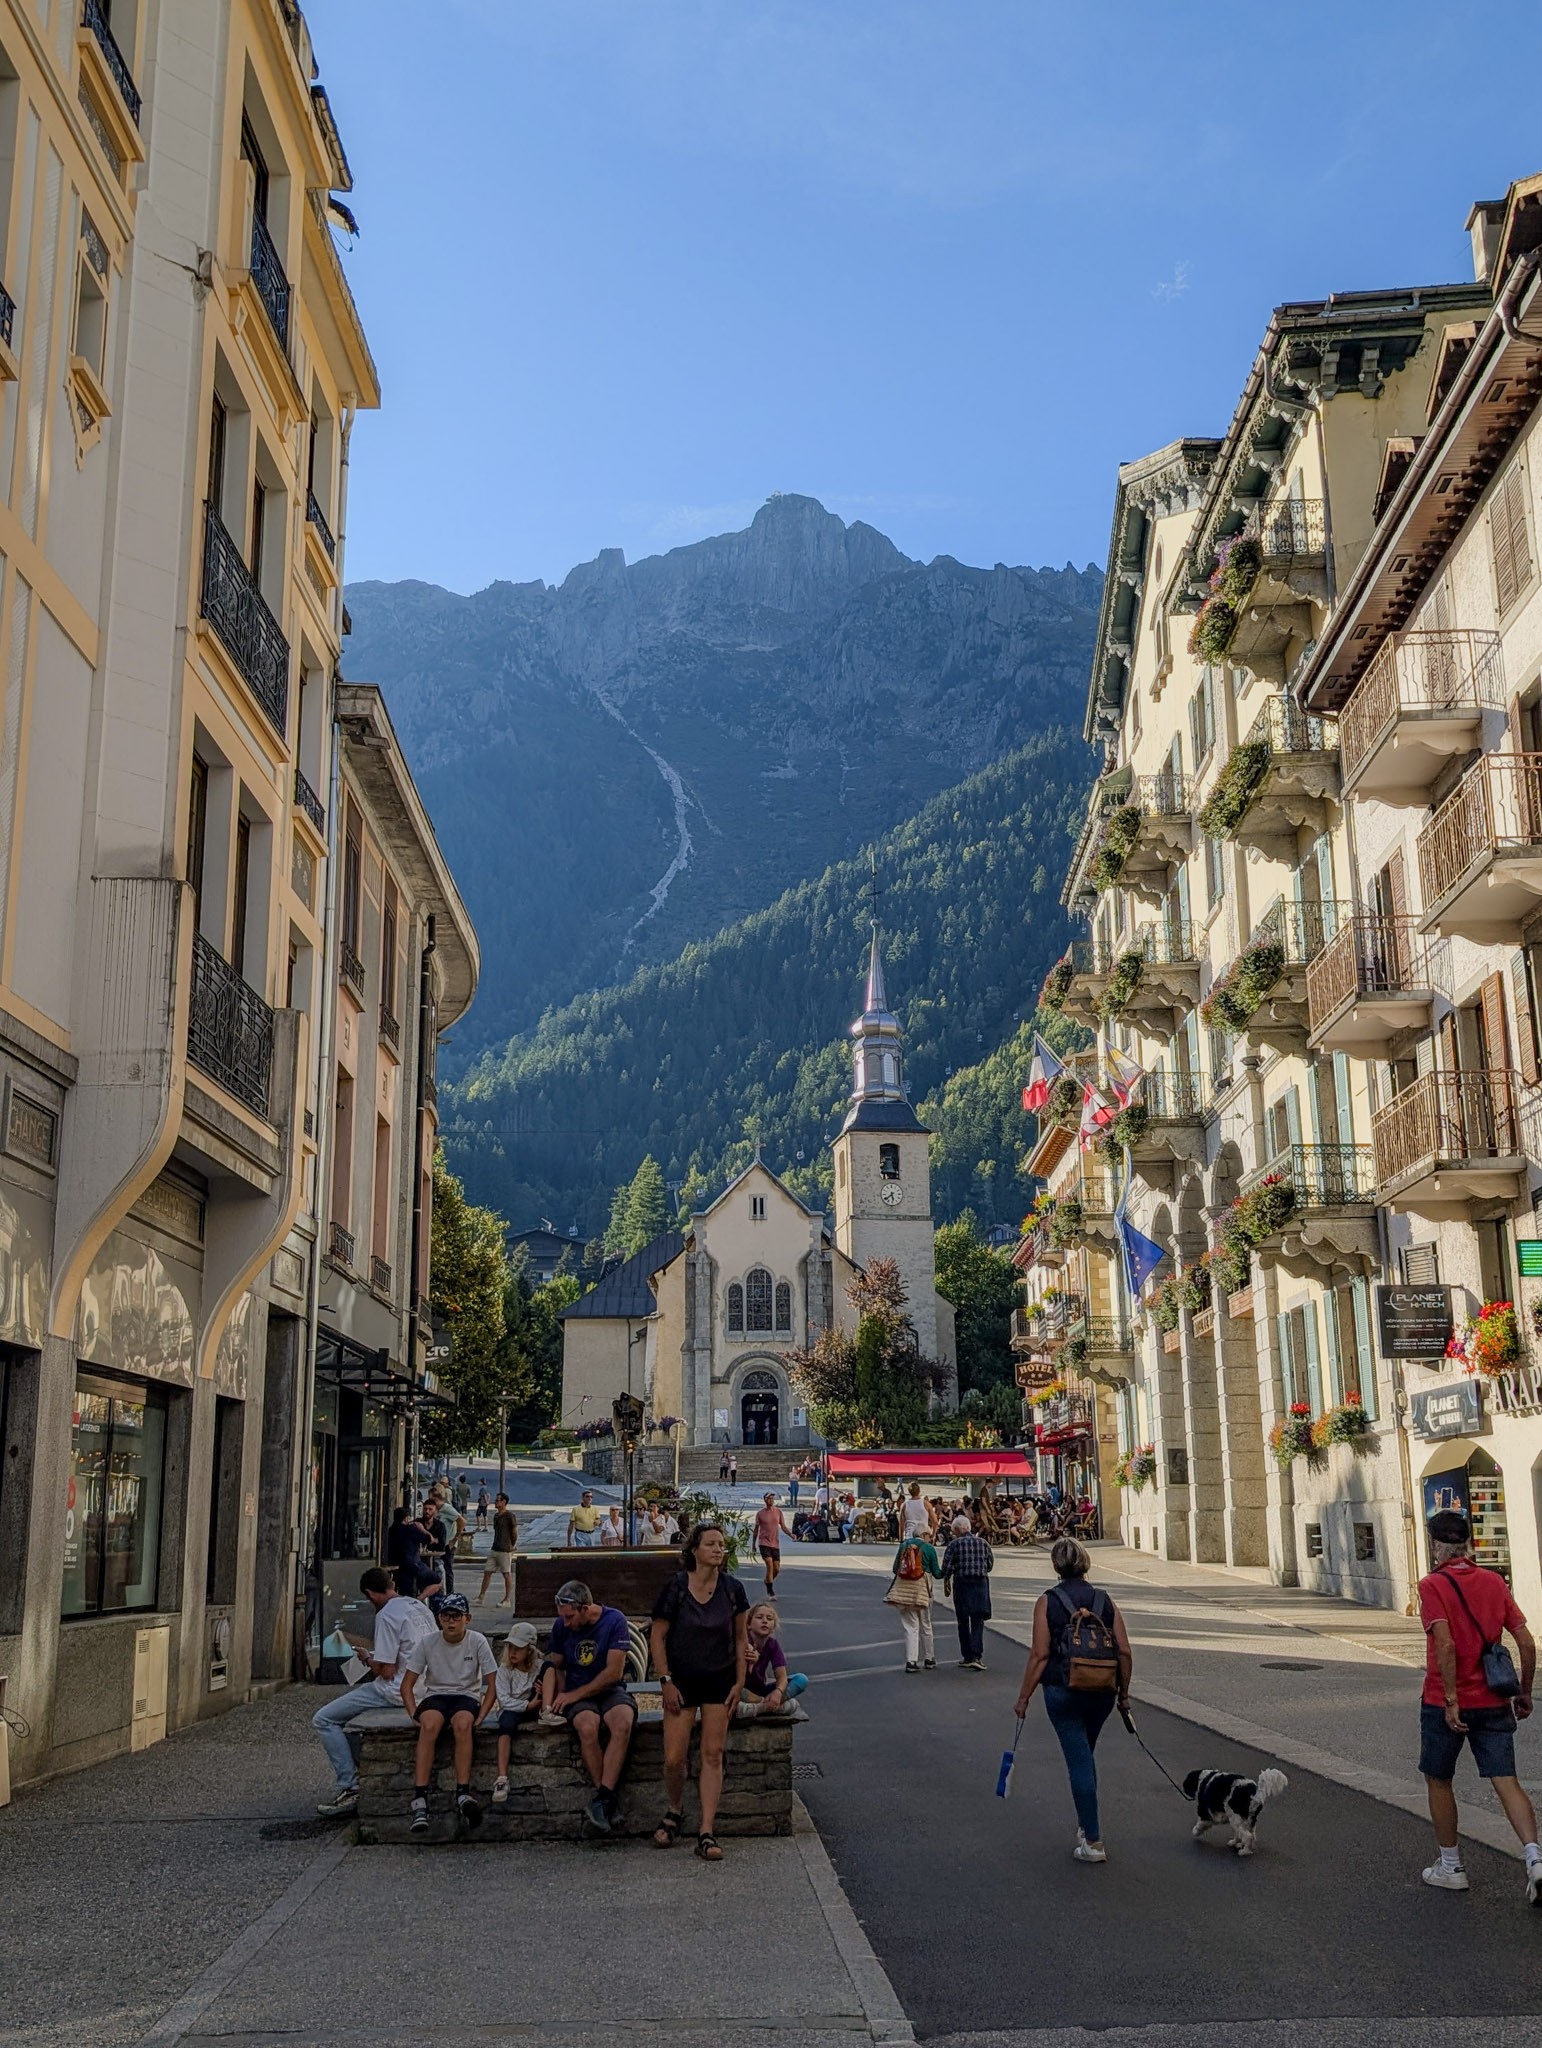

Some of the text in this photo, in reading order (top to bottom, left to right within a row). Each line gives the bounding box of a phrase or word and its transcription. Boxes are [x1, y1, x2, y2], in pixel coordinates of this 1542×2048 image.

[1395, 1293, 1443, 1302] PLANET
[1410, 1301, 1445, 1309] HI-TECH
[1018, 1363, 1053, 1374] HOTEL
[1431, 1394, 1458, 1413] PLANET
